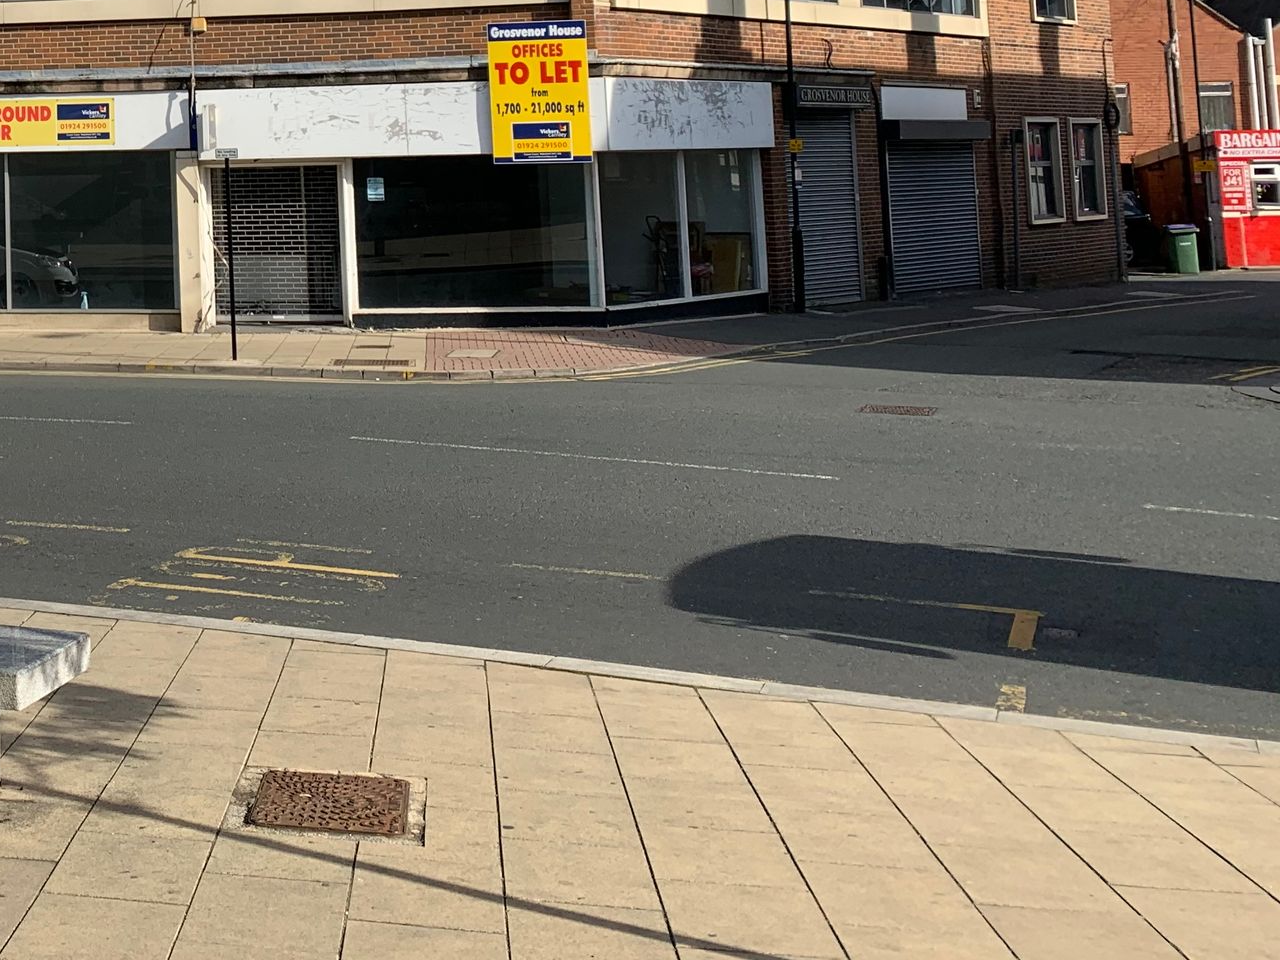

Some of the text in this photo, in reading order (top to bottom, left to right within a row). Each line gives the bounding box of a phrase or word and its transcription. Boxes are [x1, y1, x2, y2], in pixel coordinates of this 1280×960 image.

[490, 25, 583, 38] Grosvenor House
[512, 43, 563, 58] OFFICES
[494, 60, 582, 85] TO LET
[531, 88, 548, 97] from
[801, 89, 870, 102] GROSVENOR HOUSE
[496, 103, 521, 116] 1,700
[531, 102, 562, 116] 21,000
[565, 104, 575, 116] sq
[577, 100, 585, 113] ft
[541, 141, 568, 149] 291500
